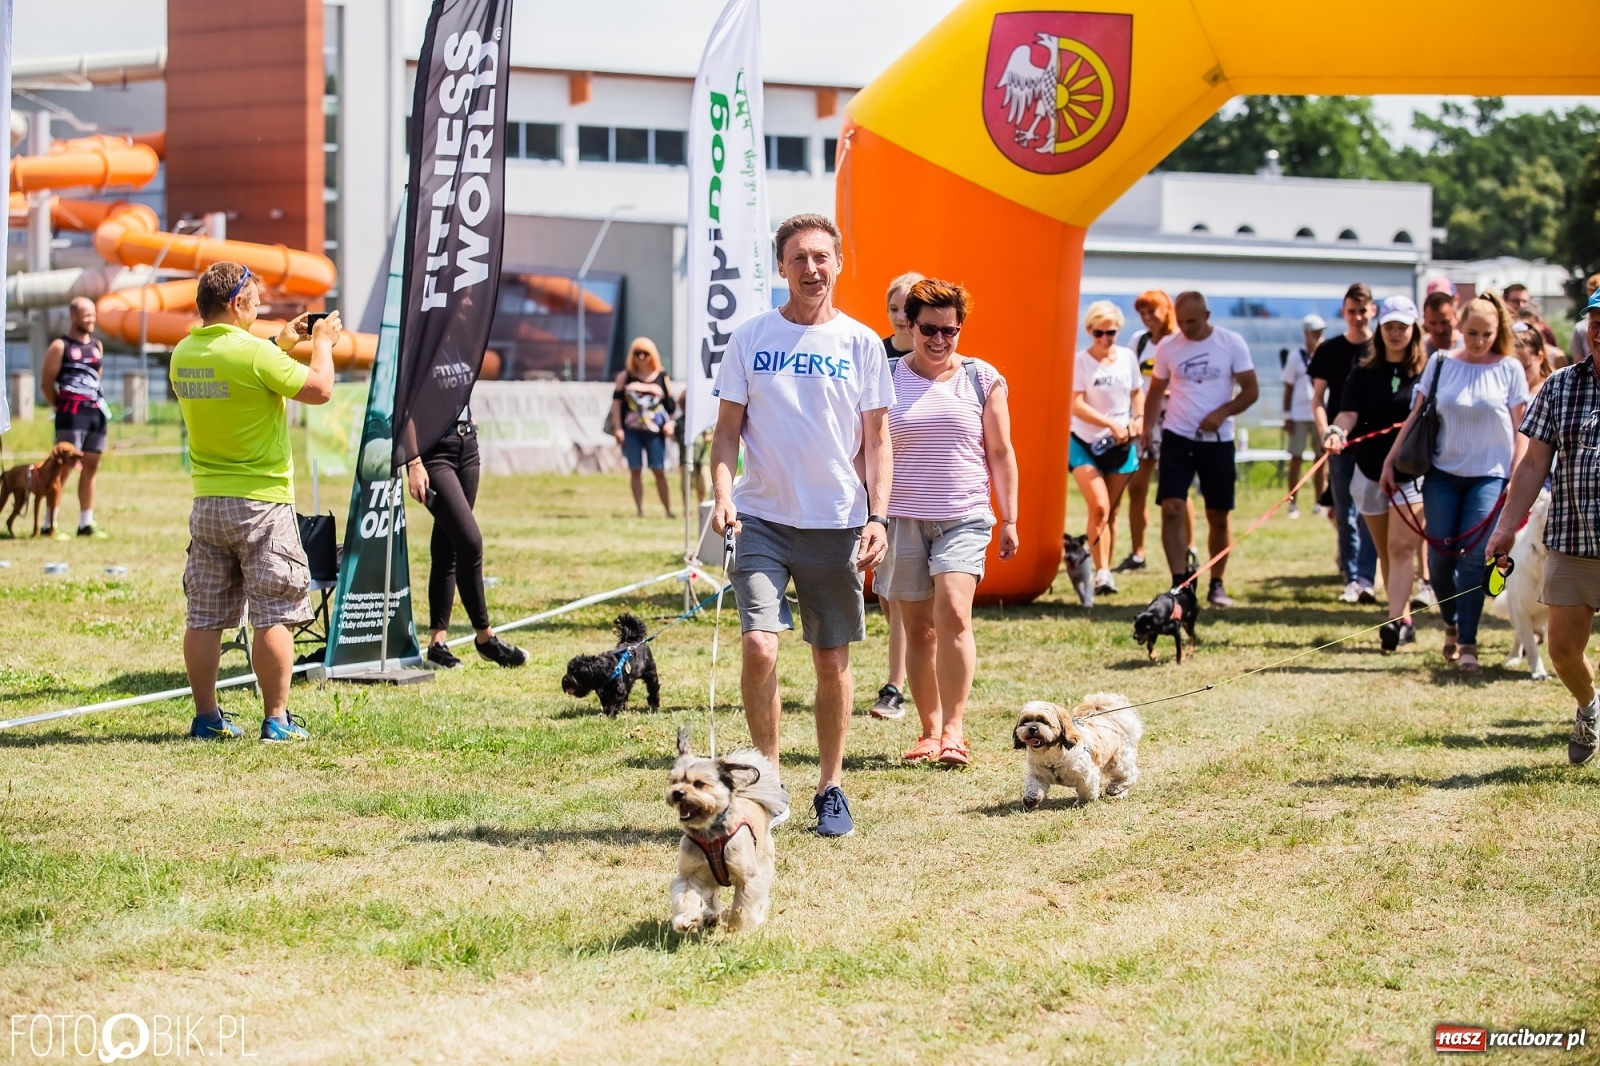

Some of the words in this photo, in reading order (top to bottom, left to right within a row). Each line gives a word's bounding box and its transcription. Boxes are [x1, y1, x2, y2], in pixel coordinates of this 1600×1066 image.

[420, 29, 483, 312] FITNESS
[177, 367, 215, 378] INSPEKTOR
[753, 350, 851, 381] DIVERSE
